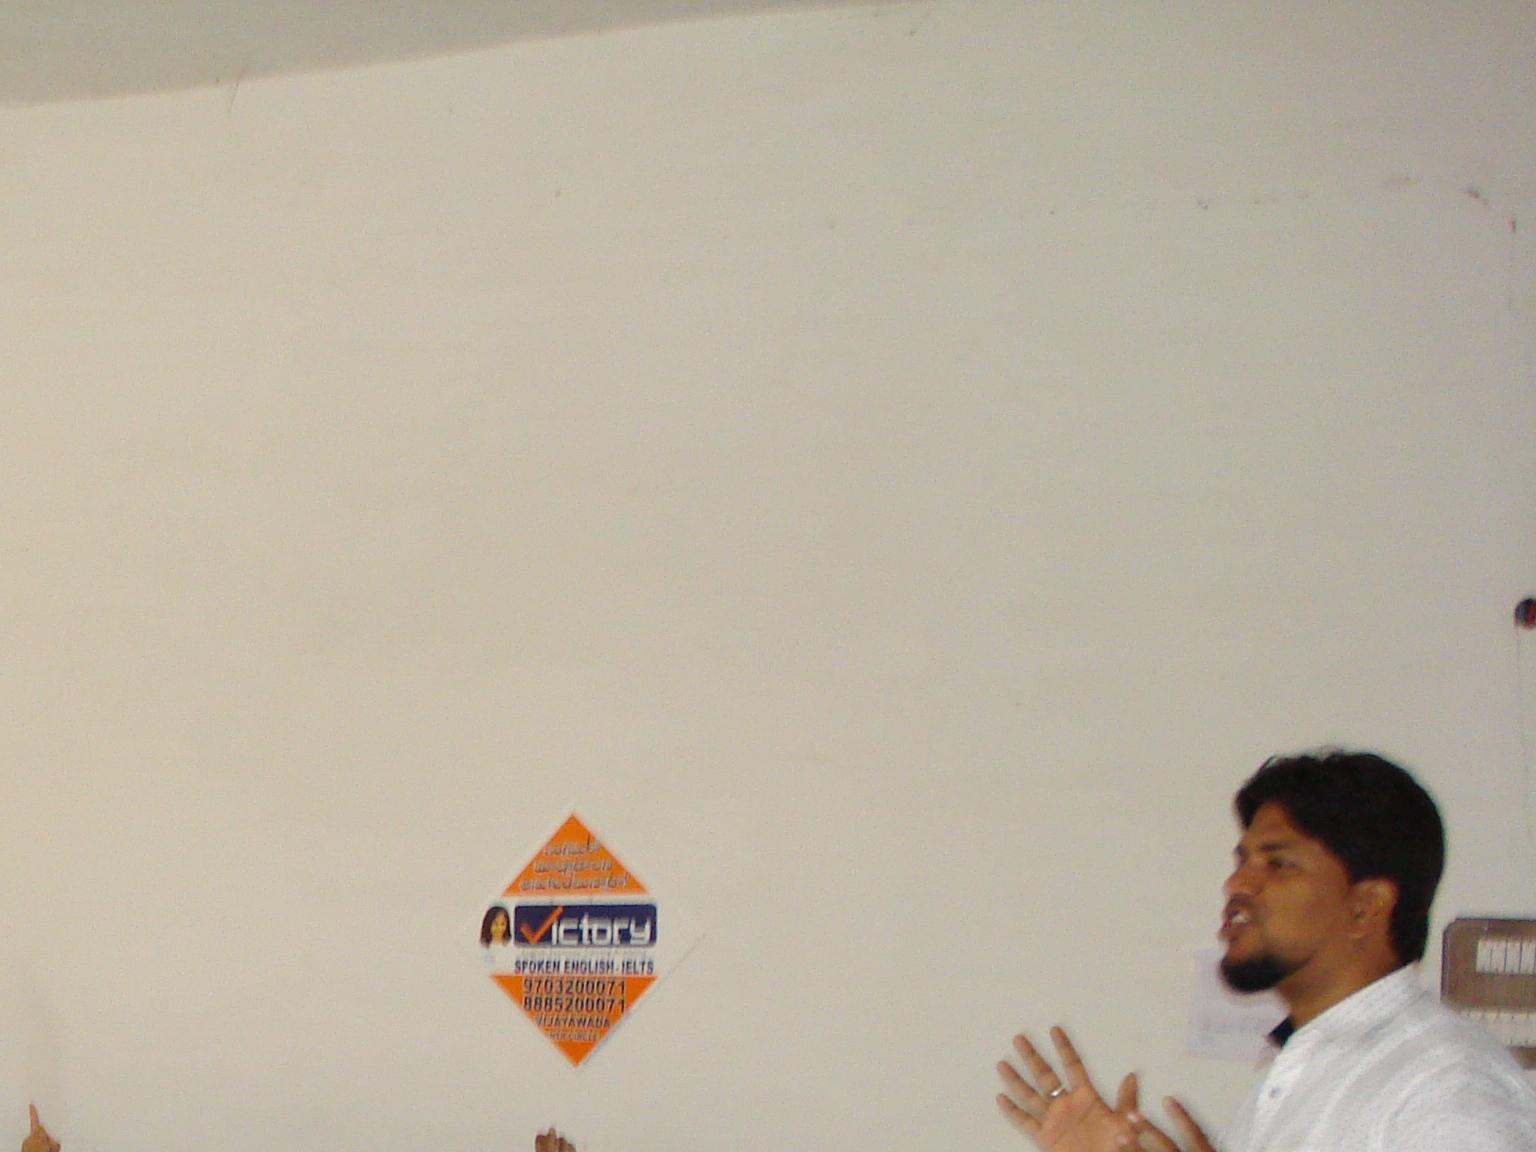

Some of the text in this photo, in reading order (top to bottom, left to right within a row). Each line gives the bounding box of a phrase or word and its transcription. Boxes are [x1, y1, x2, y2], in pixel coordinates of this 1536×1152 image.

[521, 906, 651, 946] Victory
[514, 958, 654, 975] SPOKEN ENGLISH IELTS
[523, 978, 625, 996] 9703200071
[523, 996, 625, 1013] 8885200071
